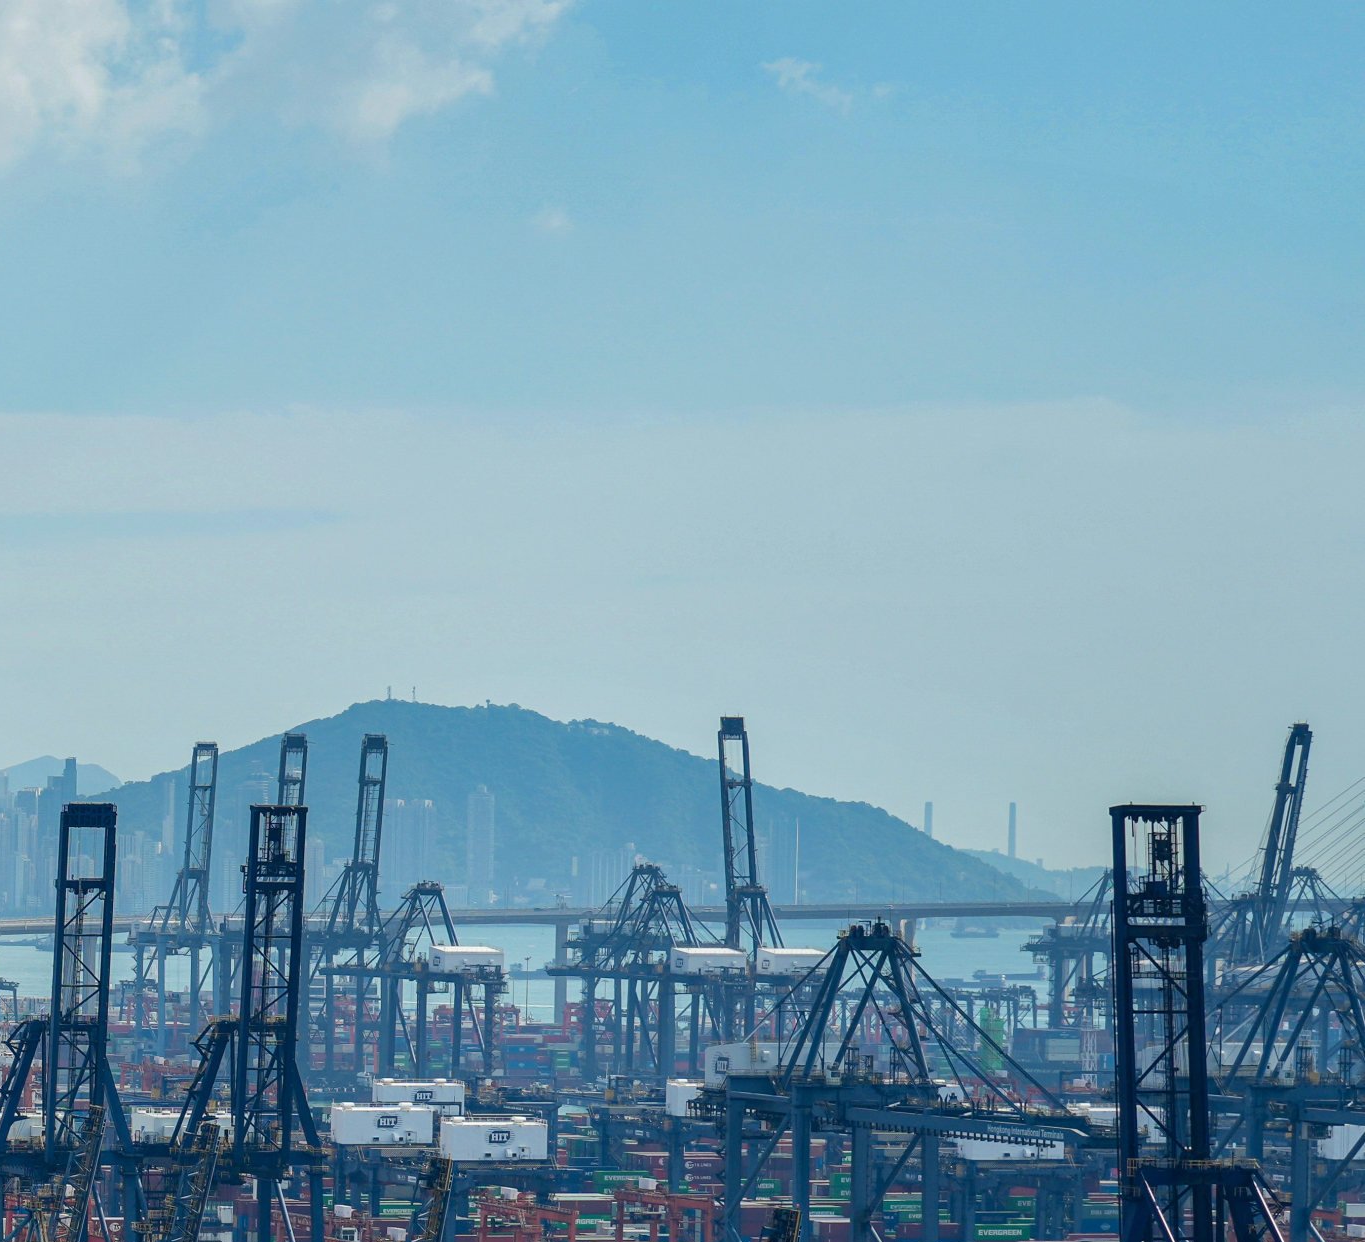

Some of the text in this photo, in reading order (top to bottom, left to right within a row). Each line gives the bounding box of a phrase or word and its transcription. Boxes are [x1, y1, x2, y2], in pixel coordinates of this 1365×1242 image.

[416, 1092, 433, 1100] HIT
[379, 1117, 396, 1127] HIT
[987, 1124, 1064, 1139] Hongkong International Terminals
[492, 1132, 509, 1141] HIT
